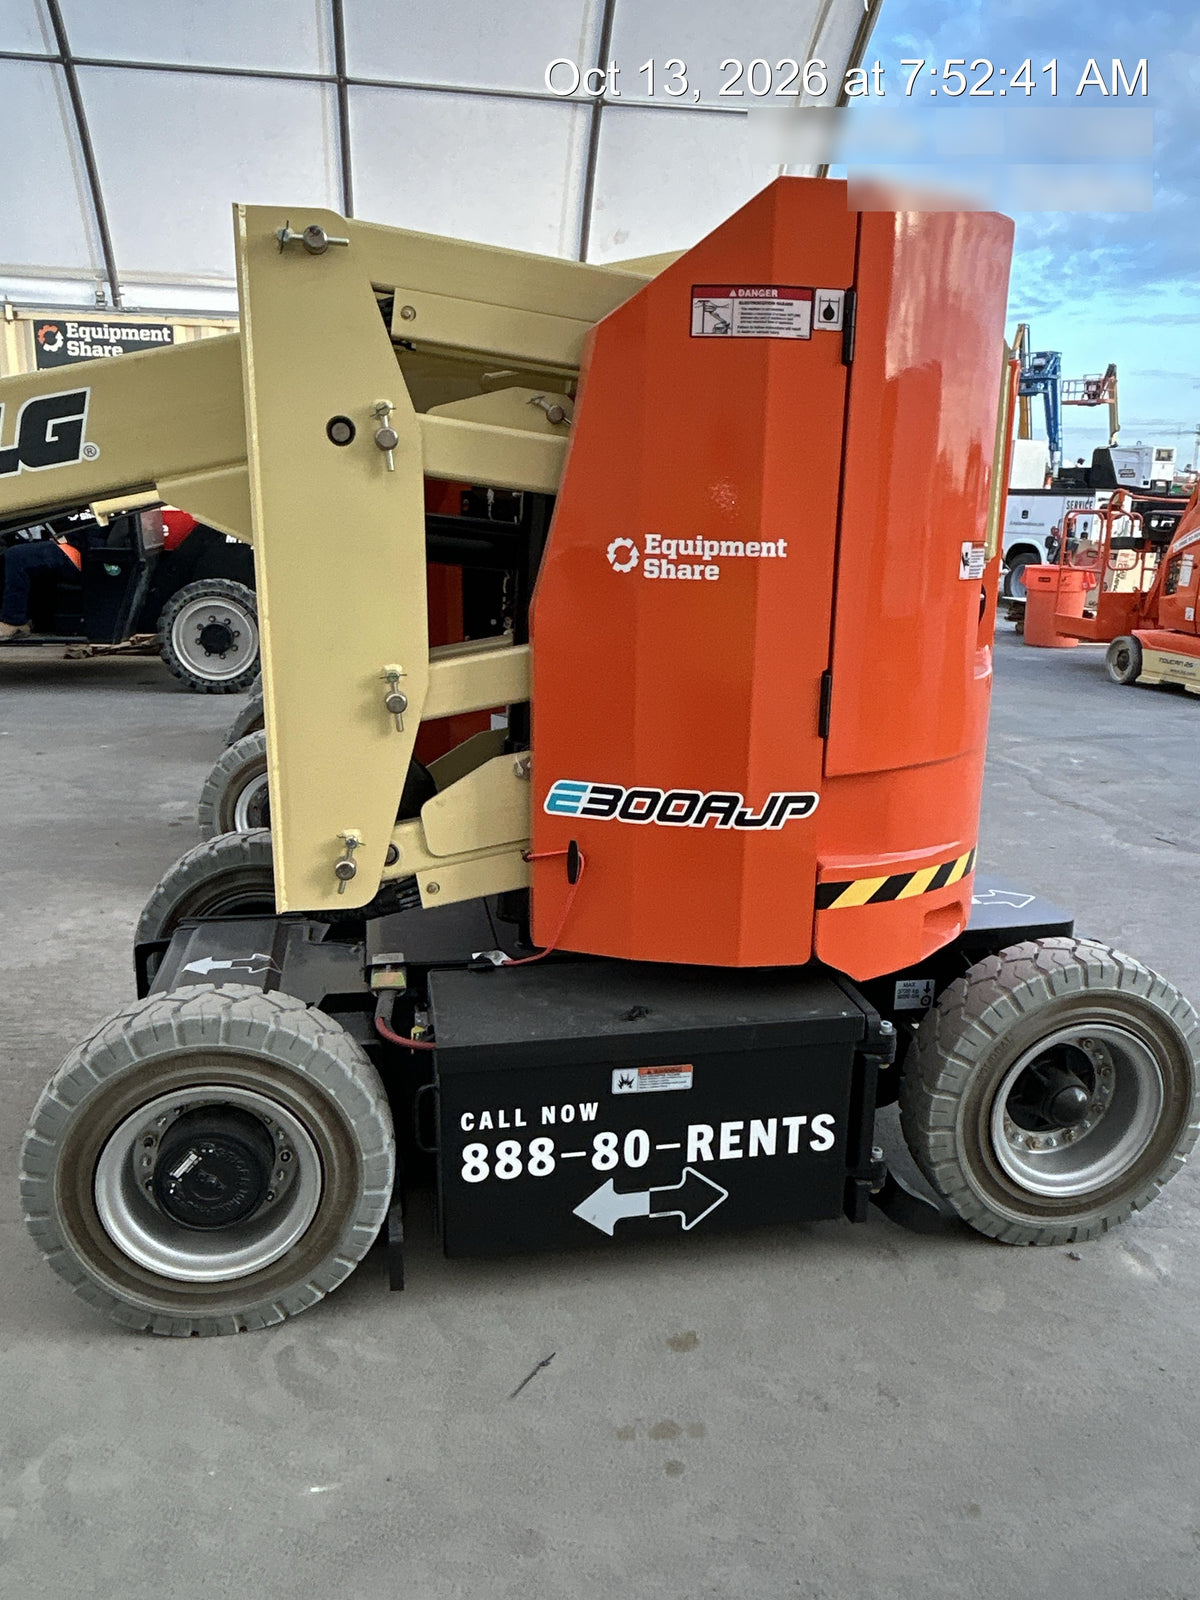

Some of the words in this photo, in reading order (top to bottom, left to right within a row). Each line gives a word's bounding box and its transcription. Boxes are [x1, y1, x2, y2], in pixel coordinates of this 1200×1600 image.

[737, 288, 778, 298] DANGER
[65, 322, 172, 343] Equipment
[67, 340, 124, 357] Share
[1066, 499, 1094, 510] SERVICE
[644, 533, 788, 560] Equipment
[643, 558, 720, 580] Share
[543, 779, 820, 830] E300AJP
[460, 1108, 527, 1131] CALL
[541, 1102, 599, 1126] NOW
